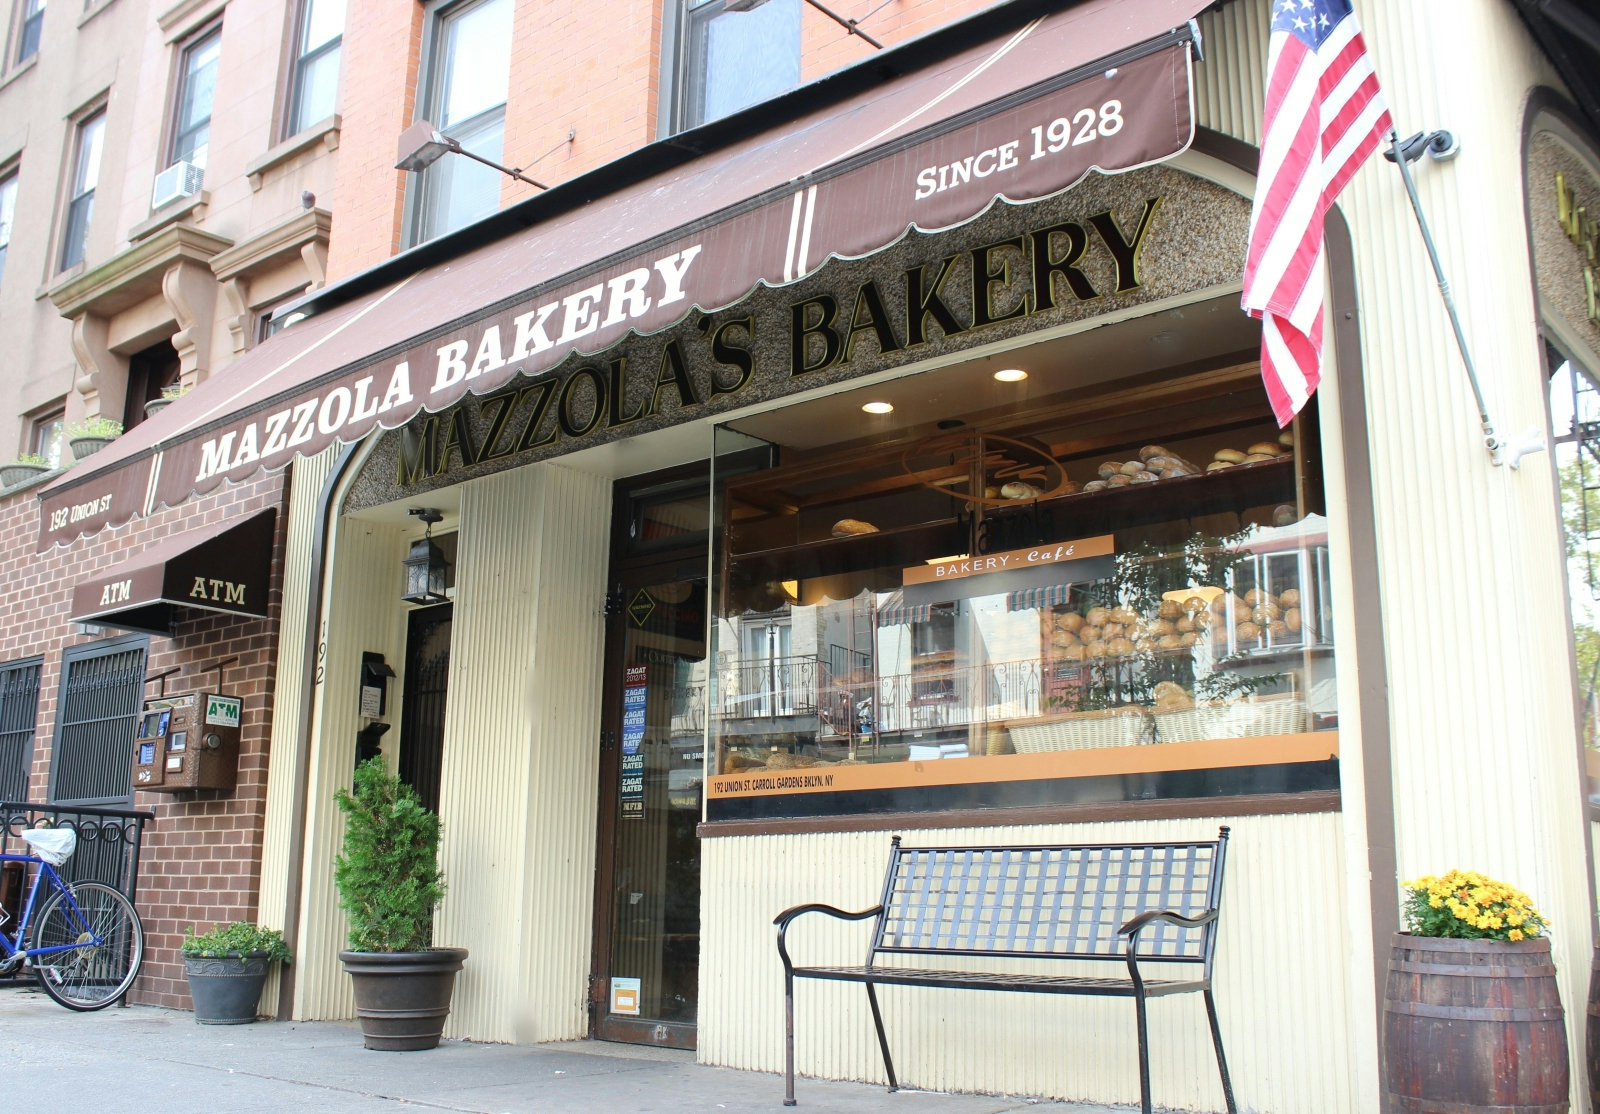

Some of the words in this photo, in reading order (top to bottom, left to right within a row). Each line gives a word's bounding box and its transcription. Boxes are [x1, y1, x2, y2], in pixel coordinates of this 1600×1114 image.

[915, 140, 1020, 201] SINCE
[1030, 100, 1124, 162] 1928
[395, 316, 757, 488] MAZZOLA'S
[789, 196, 1165, 380] BAKERY
[195, 361, 414, 483] MAZZOLA
[430, 244, 702, 393] BAKERY
[48, 506, 69, 533] 192
[70, 498, 100, 524] UNION
[99, 493, 113, 513] ST
[936, 555, 1010, 578] BAKERY
[1027, 545, 1075, 563] Café
[100, 579, 132, 606] ATM
[189, 576, 246, 606] ATM
[315, 620, 327, 686] 192
[626, 666, 647, 675] ZAGAT
[625, 688, 646, 697] ZAGAT
[624, 695, 646, 704] RATED
[624, 710, 645, 719] ZAGAT
[623, 718, 645, 726] RATED
[623, 732, 644, 741] ZAGAT
[623, 739, 640, 748] RATE
[622, 754, 644, 763] ZAGAT
[622, 761, 643, 770] RATED
[622, 777, 643, 786] ZAGAT
[714, 782, 724, 793] 192
[724, 780, 743, 793] UNION
[752, 778, 776, 791] CARROLL
[776, 776, 803, 789] GARDENS
[825, 774, 834, 786] NY
[621, 784, 643, 793] RATED
